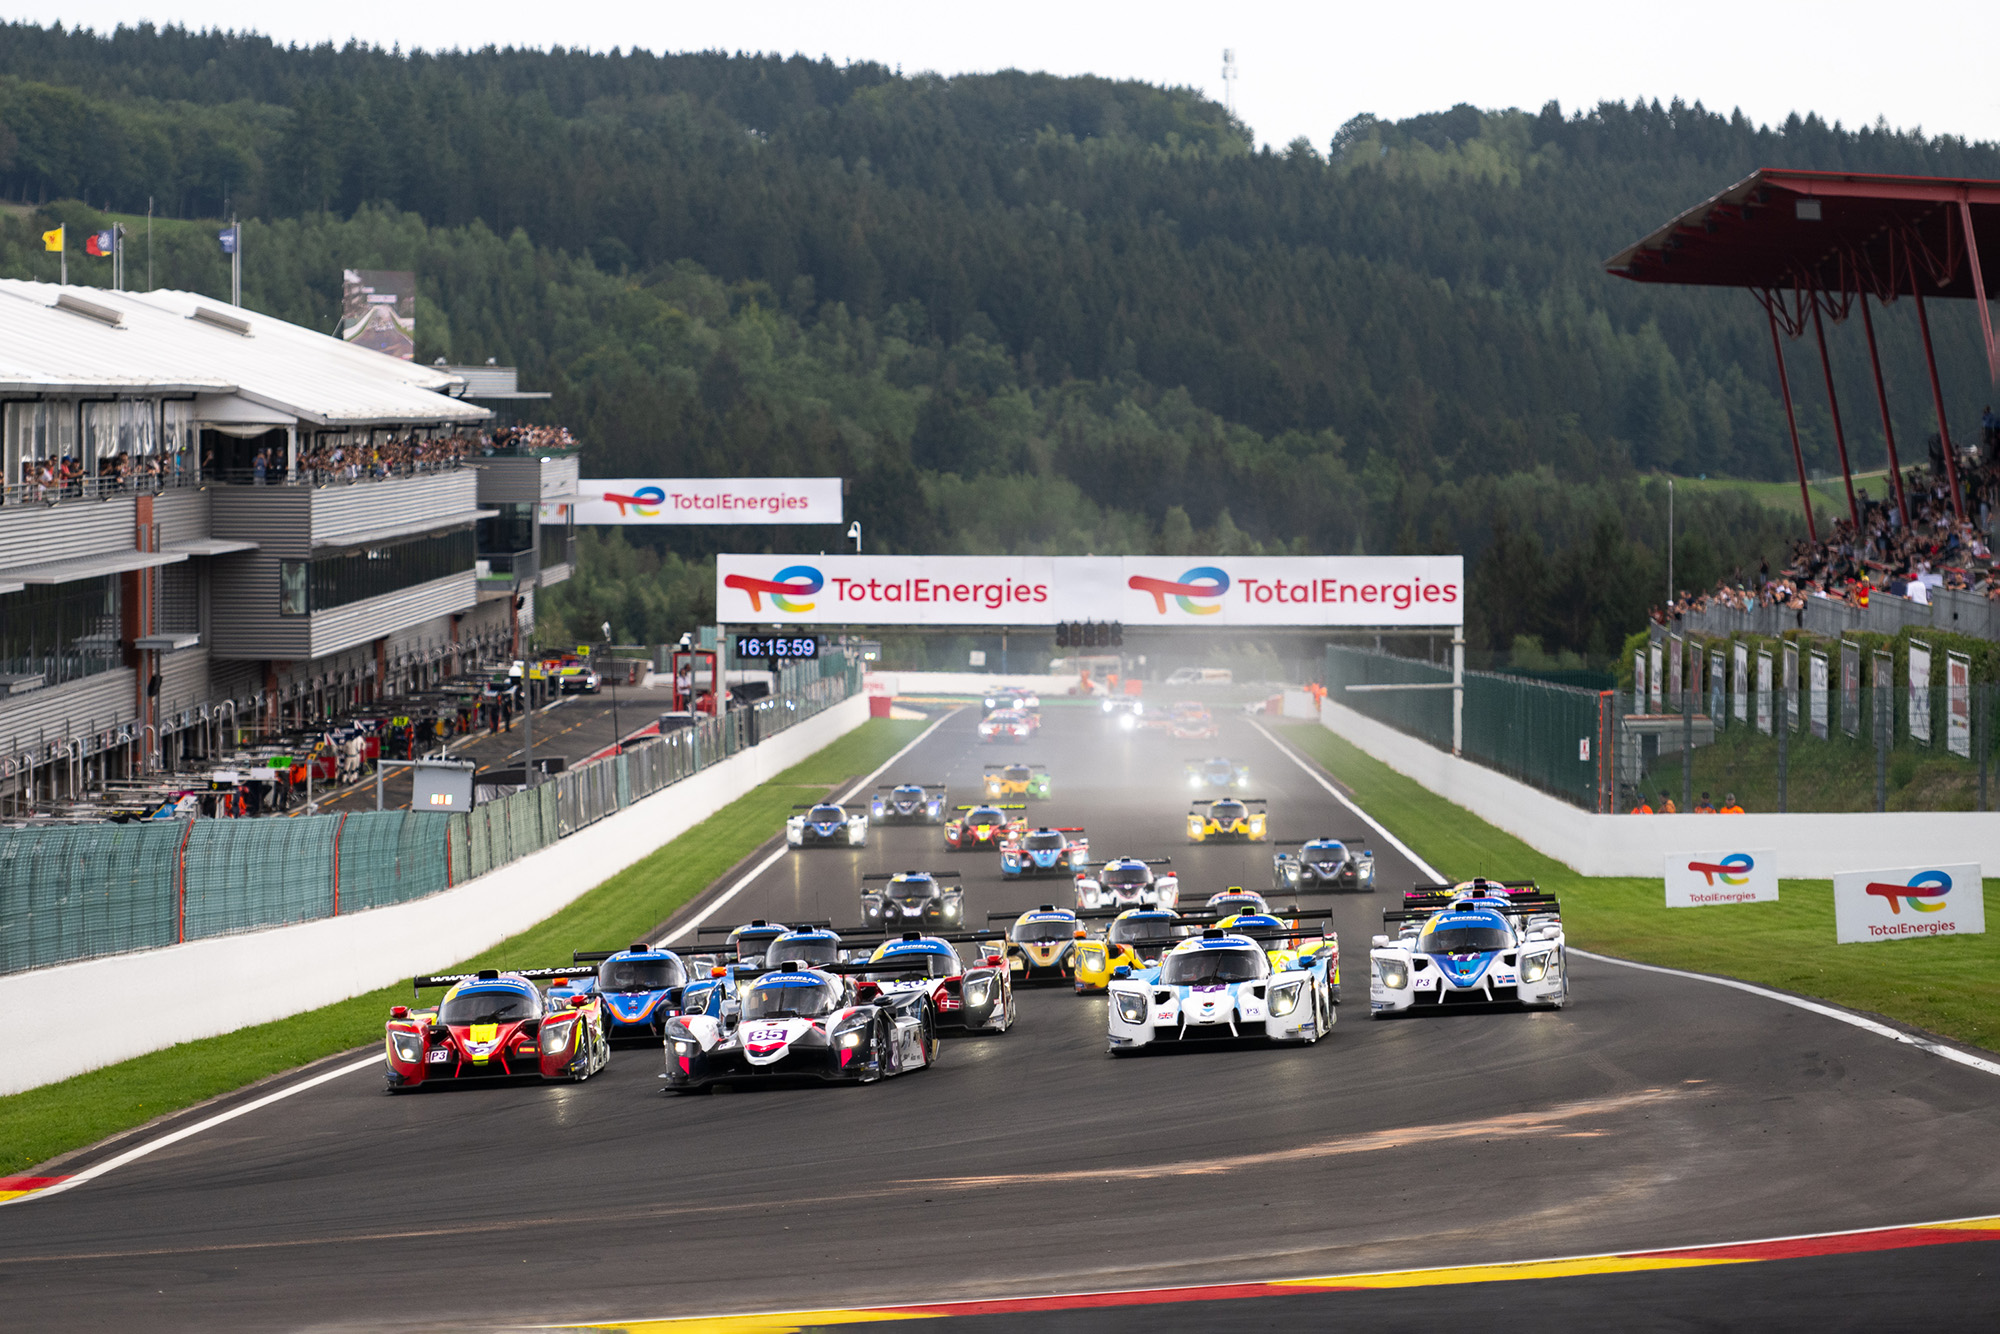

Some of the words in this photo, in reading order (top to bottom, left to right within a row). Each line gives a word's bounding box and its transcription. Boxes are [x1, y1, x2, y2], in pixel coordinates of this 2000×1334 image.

[670, 494, 808, 513] TotalEnergies
[832, 578, 1048, 609] TotalEnergies
[1239, 578, 1458, 610] TotalEnergies
[738, 638, 816, 657] 16:15:59
[1689, 891, 1756, 903] TotalEnergies
[1868, 920, 1956, 937] TotalEnergies
[473, 980, 527, 988] MICHELIN
[769, 976, 820, 984] MICHELIN
[1416, 978, 1430, 987] P3
[1246, 1007, 1259, 1015] P3
[750, 1029, 784, 1041] 85
[431, 1051, 447, 1062] P3
